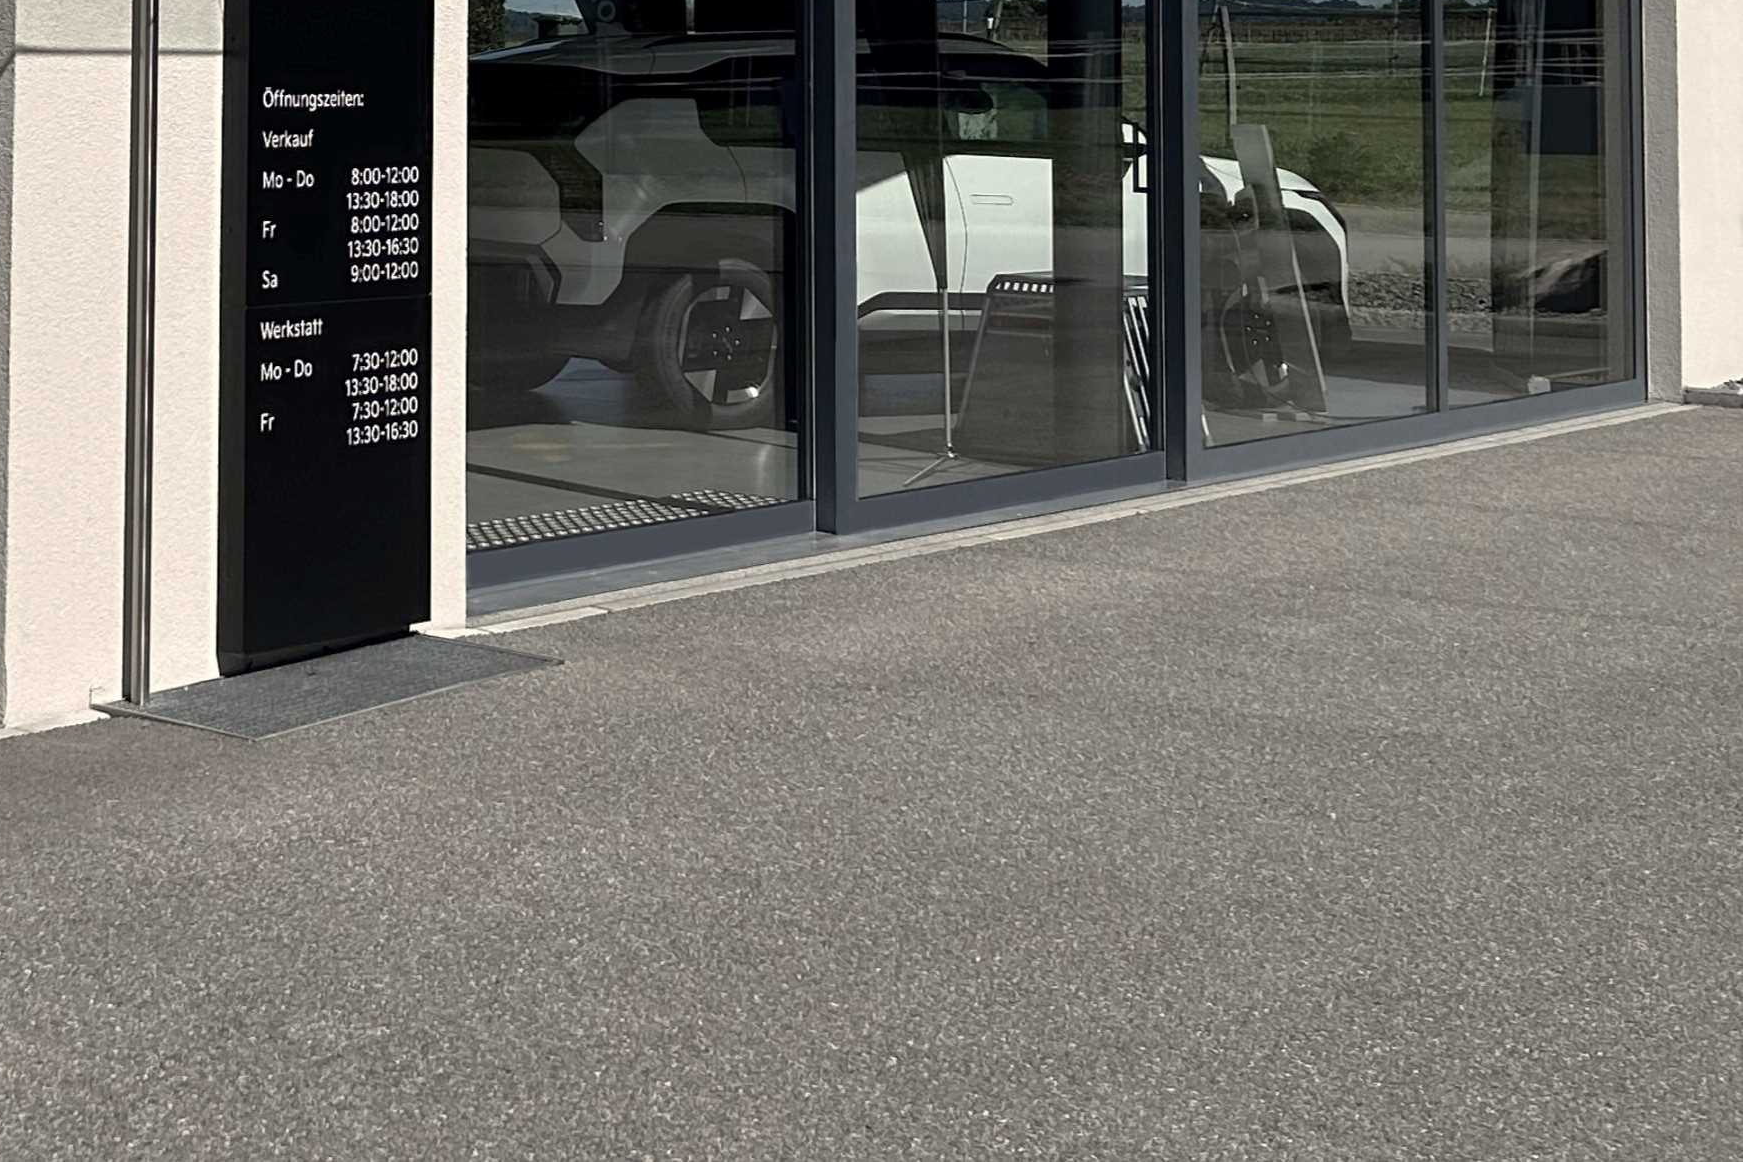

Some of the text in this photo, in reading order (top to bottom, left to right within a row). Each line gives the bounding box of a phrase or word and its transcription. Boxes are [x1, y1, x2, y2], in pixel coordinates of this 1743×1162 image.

[262, 87, 365, 112] Öffnungszeiten:
[262, 129, 314, 148] Verkauf
[262, 171, 284, 189] Mo
[296, 169, 315, 188] Do
[351, 165, 419, 186] 8:00-12:00
[346, 190, 419, 210] 13:30-18:00
[262, 213, 419, 238] Fr 8:00-12:00
[347, 237, 419, 258] 13:30-16:30
[262, 261, 419, 288] Sa 9:00-12:00
[260, 318, 324, 340] Werkstatt
[260, 362, 282, 382] Mo
[294, 359, 313, 378] Do
[352, 348, 418, 372] 7:30-12:00
[345, 372, 418, 397] 13:30-18:00
[260, 396, 418, 432] Fr 7:30-12:00
[346, 420, 418, 446] 13:30-16:30
